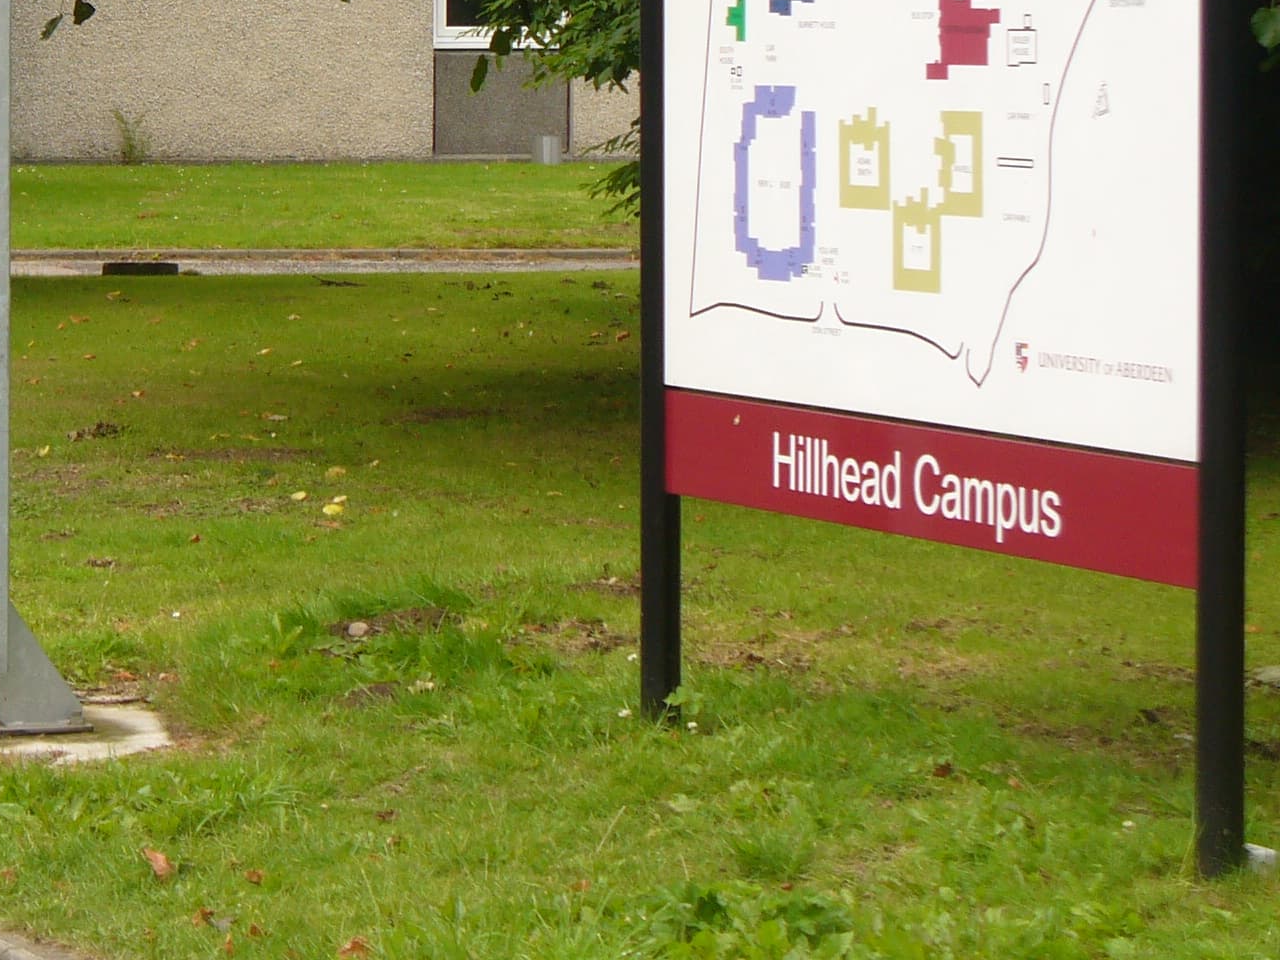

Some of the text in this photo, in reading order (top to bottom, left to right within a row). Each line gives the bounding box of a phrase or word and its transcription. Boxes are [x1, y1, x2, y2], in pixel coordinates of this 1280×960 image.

[1038, 351, 1101, 375] UNIVERSITY
[1116, 361, 1173, 383] ABERDEEN
[772, 431, 1062, 543] Hillhead Campus
